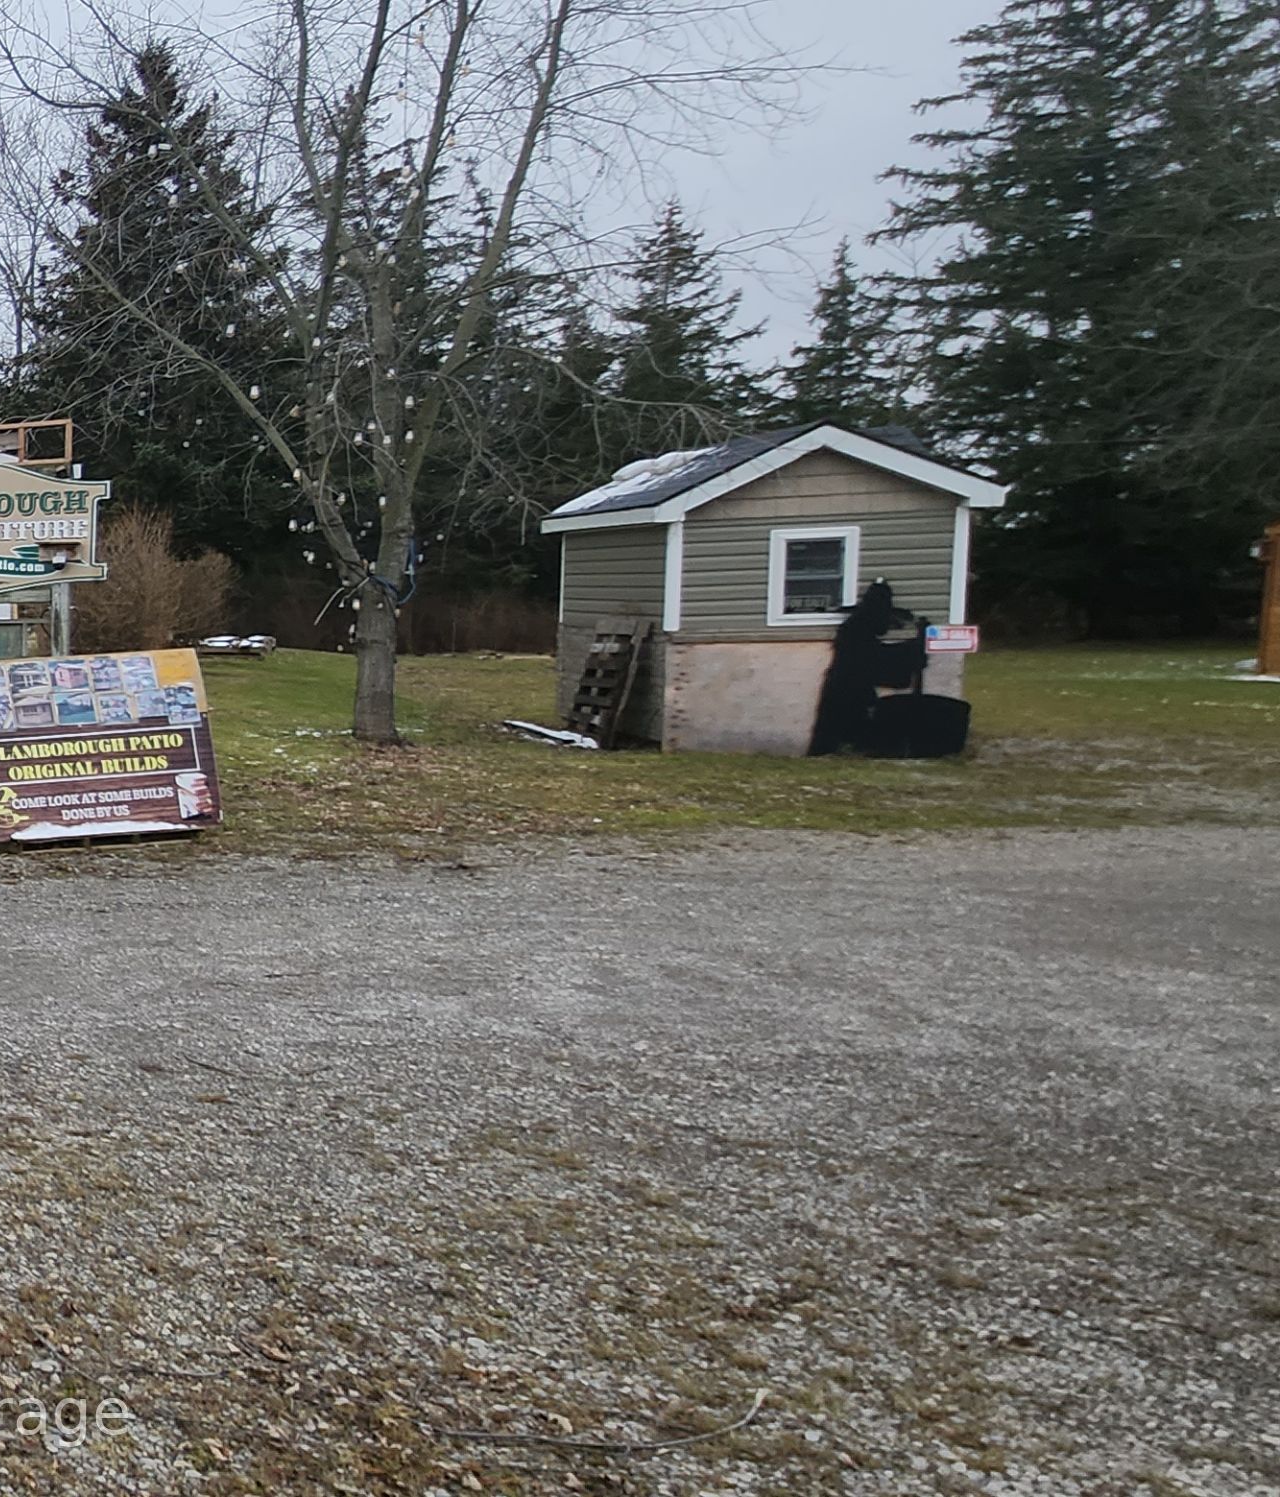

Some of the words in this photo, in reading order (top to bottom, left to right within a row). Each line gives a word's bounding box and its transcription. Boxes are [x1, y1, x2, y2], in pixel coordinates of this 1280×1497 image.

[129, 733, 184, 751] PATIO
[7, 760, 98, 781] ORIGINAL
[100, 755, 169, 774] BUILDS
[11, 797, 48, 810] COME
[48, 794, 81, 807] LOOK
[81, 792, 97, 805] AT
[98, 790, 133, 804] SOME
[133, 787, 175, 801] BUILDS
[61, 808, 97, 821] DONE
[97, 806, 112, 819] BY
[112, 804, 130, 817] US
